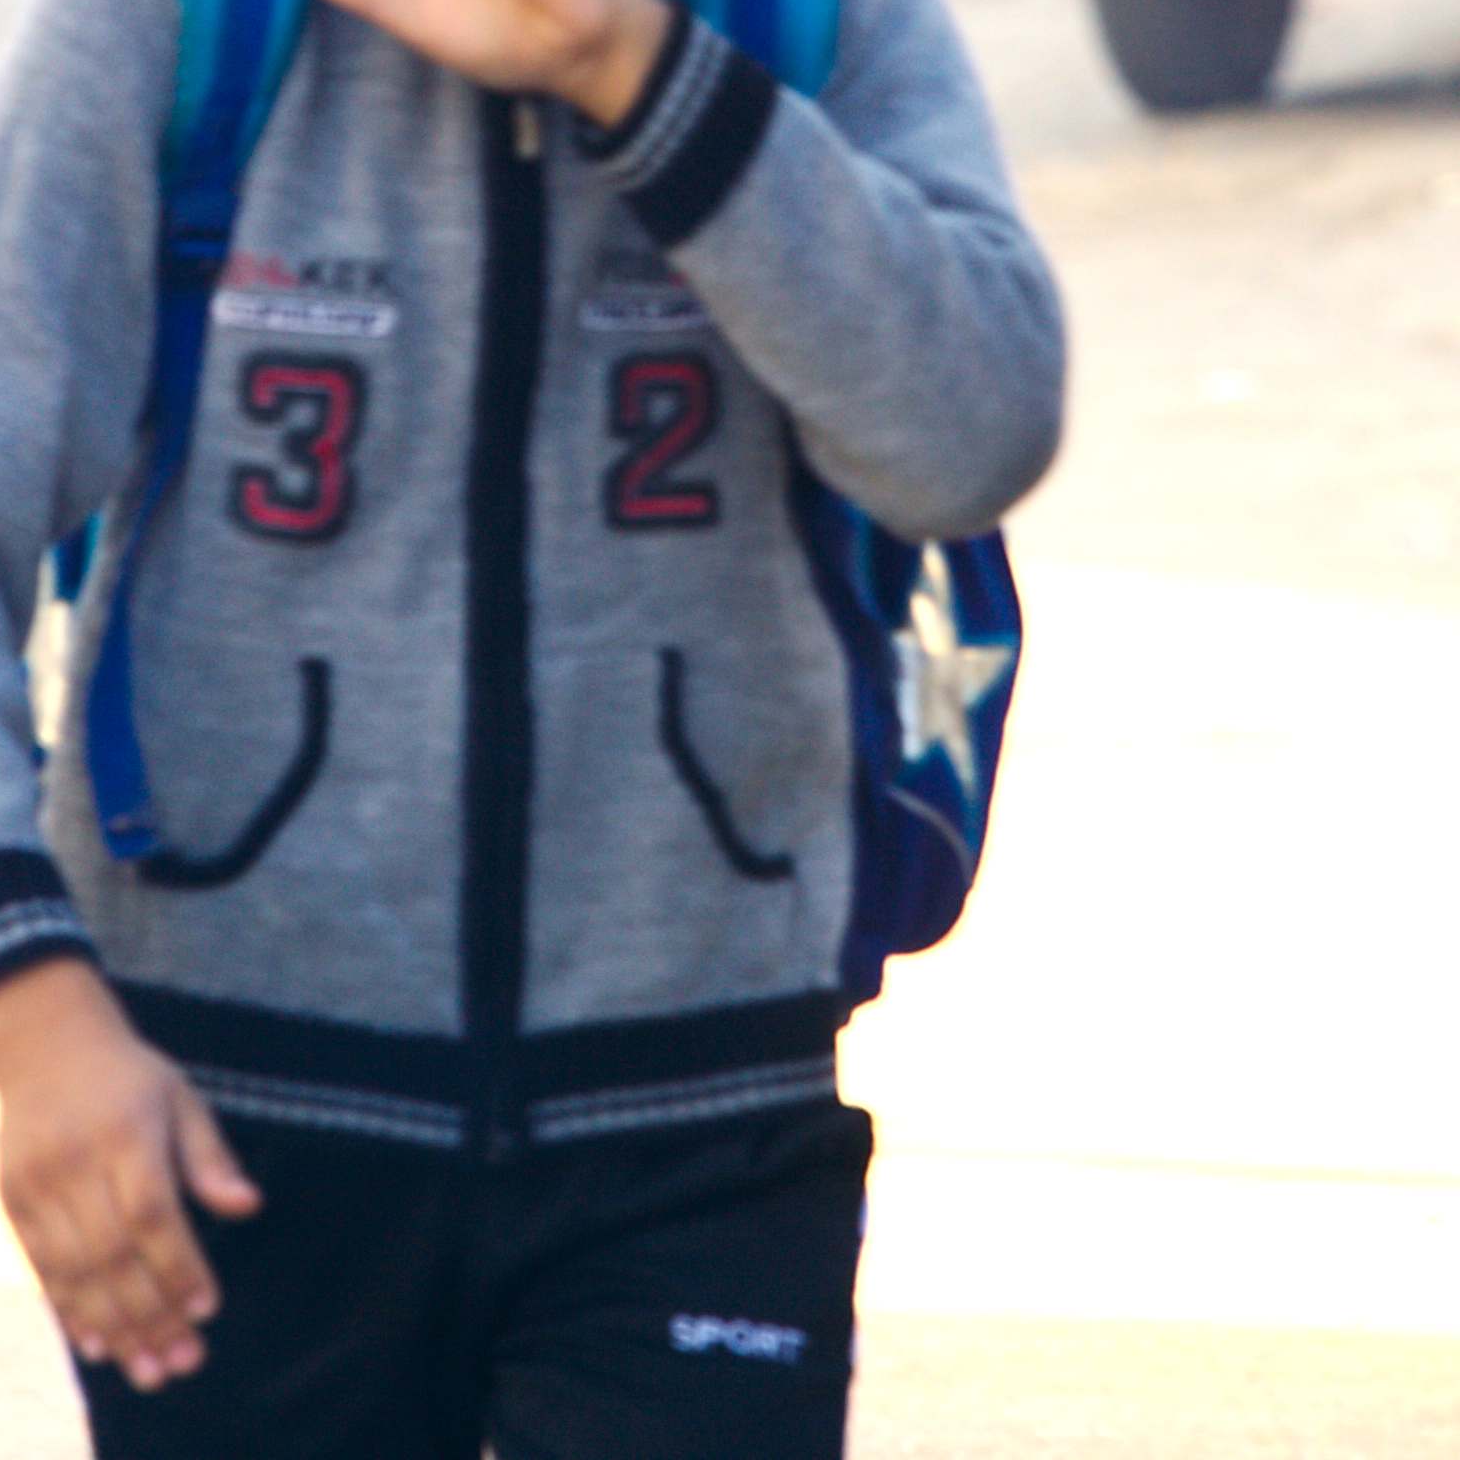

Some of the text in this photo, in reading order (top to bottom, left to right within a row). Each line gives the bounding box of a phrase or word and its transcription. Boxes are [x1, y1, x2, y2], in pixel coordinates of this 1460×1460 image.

[230, 352, 718, 538] 3 2
[668, 1314, 806, 1366] SPORT
